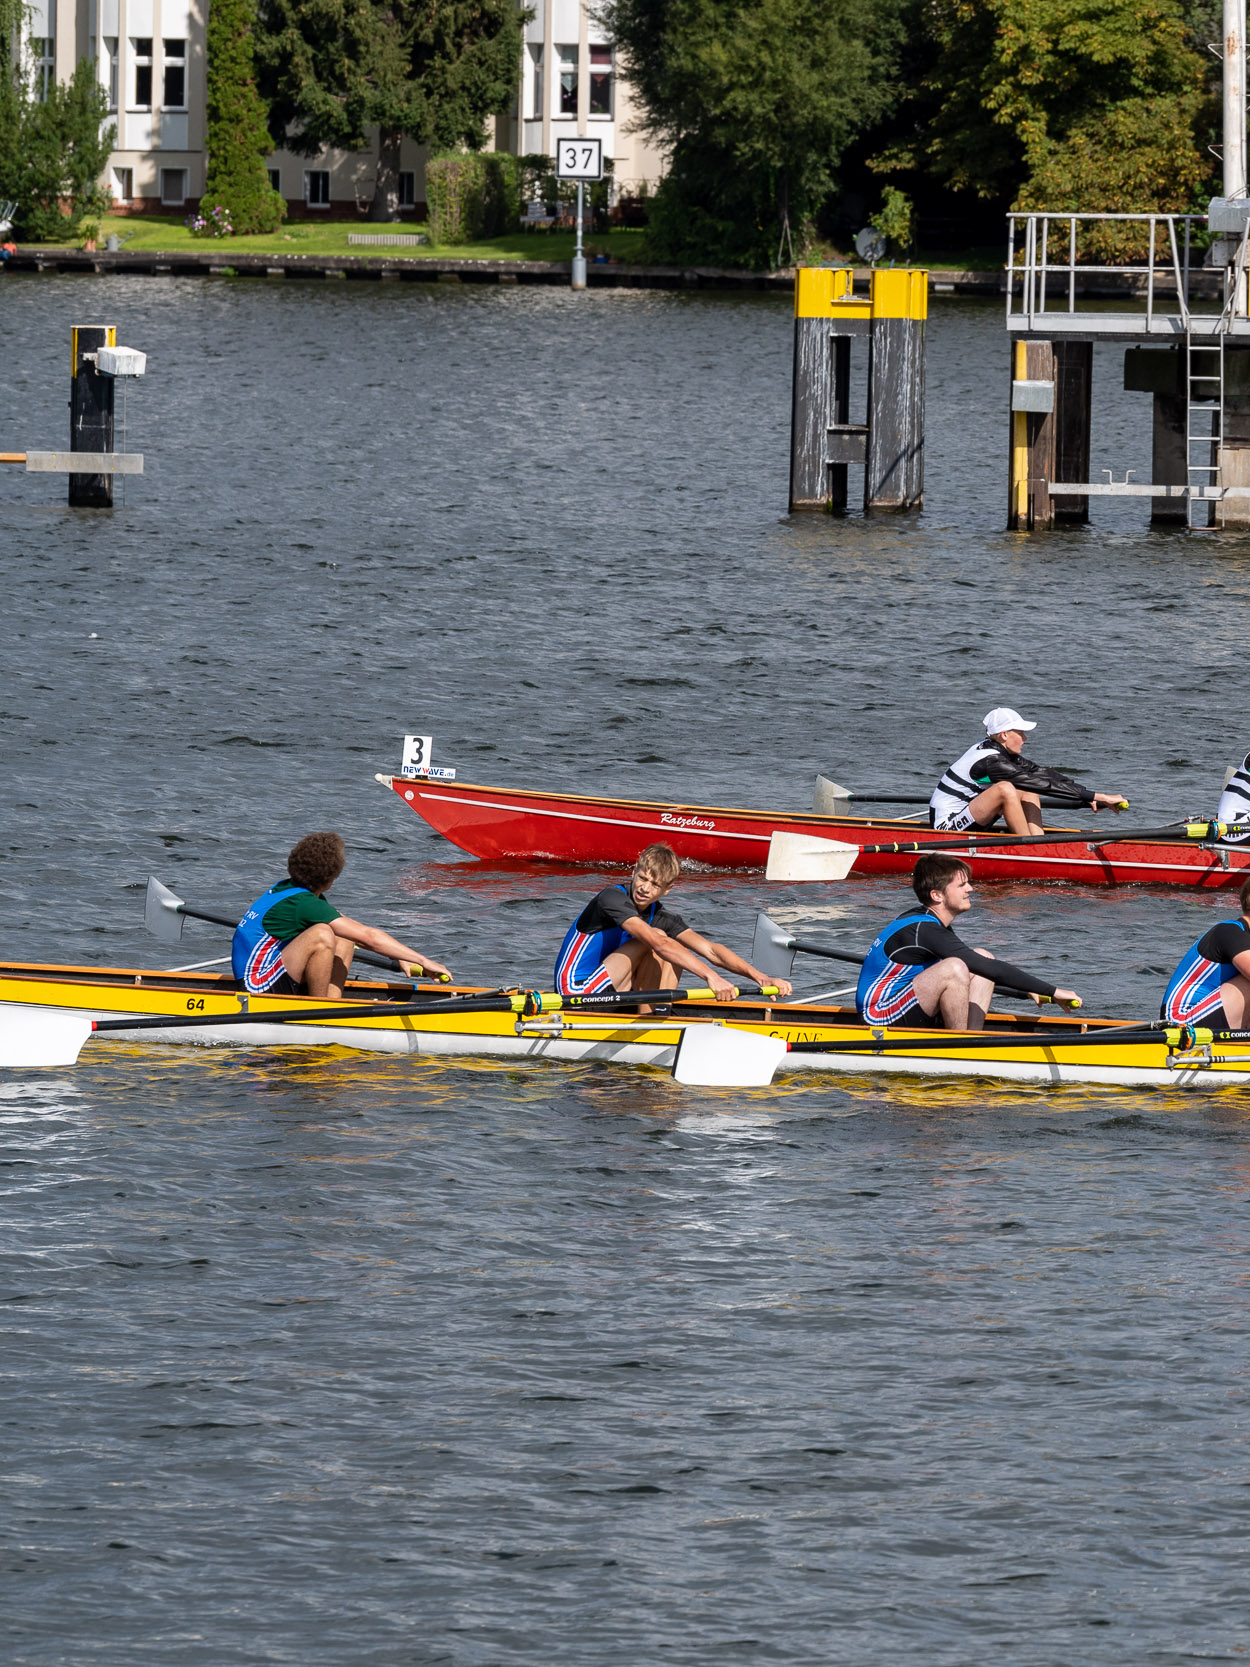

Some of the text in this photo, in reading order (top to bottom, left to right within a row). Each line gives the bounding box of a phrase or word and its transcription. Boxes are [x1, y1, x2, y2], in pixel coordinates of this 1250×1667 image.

[565, 147, 593, 169] 37
[410, 737, 424, 765] 3
[660, 812, 716, 831] Ratzeburg
[186, 998, 205, 1011] 64
[582, 995, 614, 1003] concept
